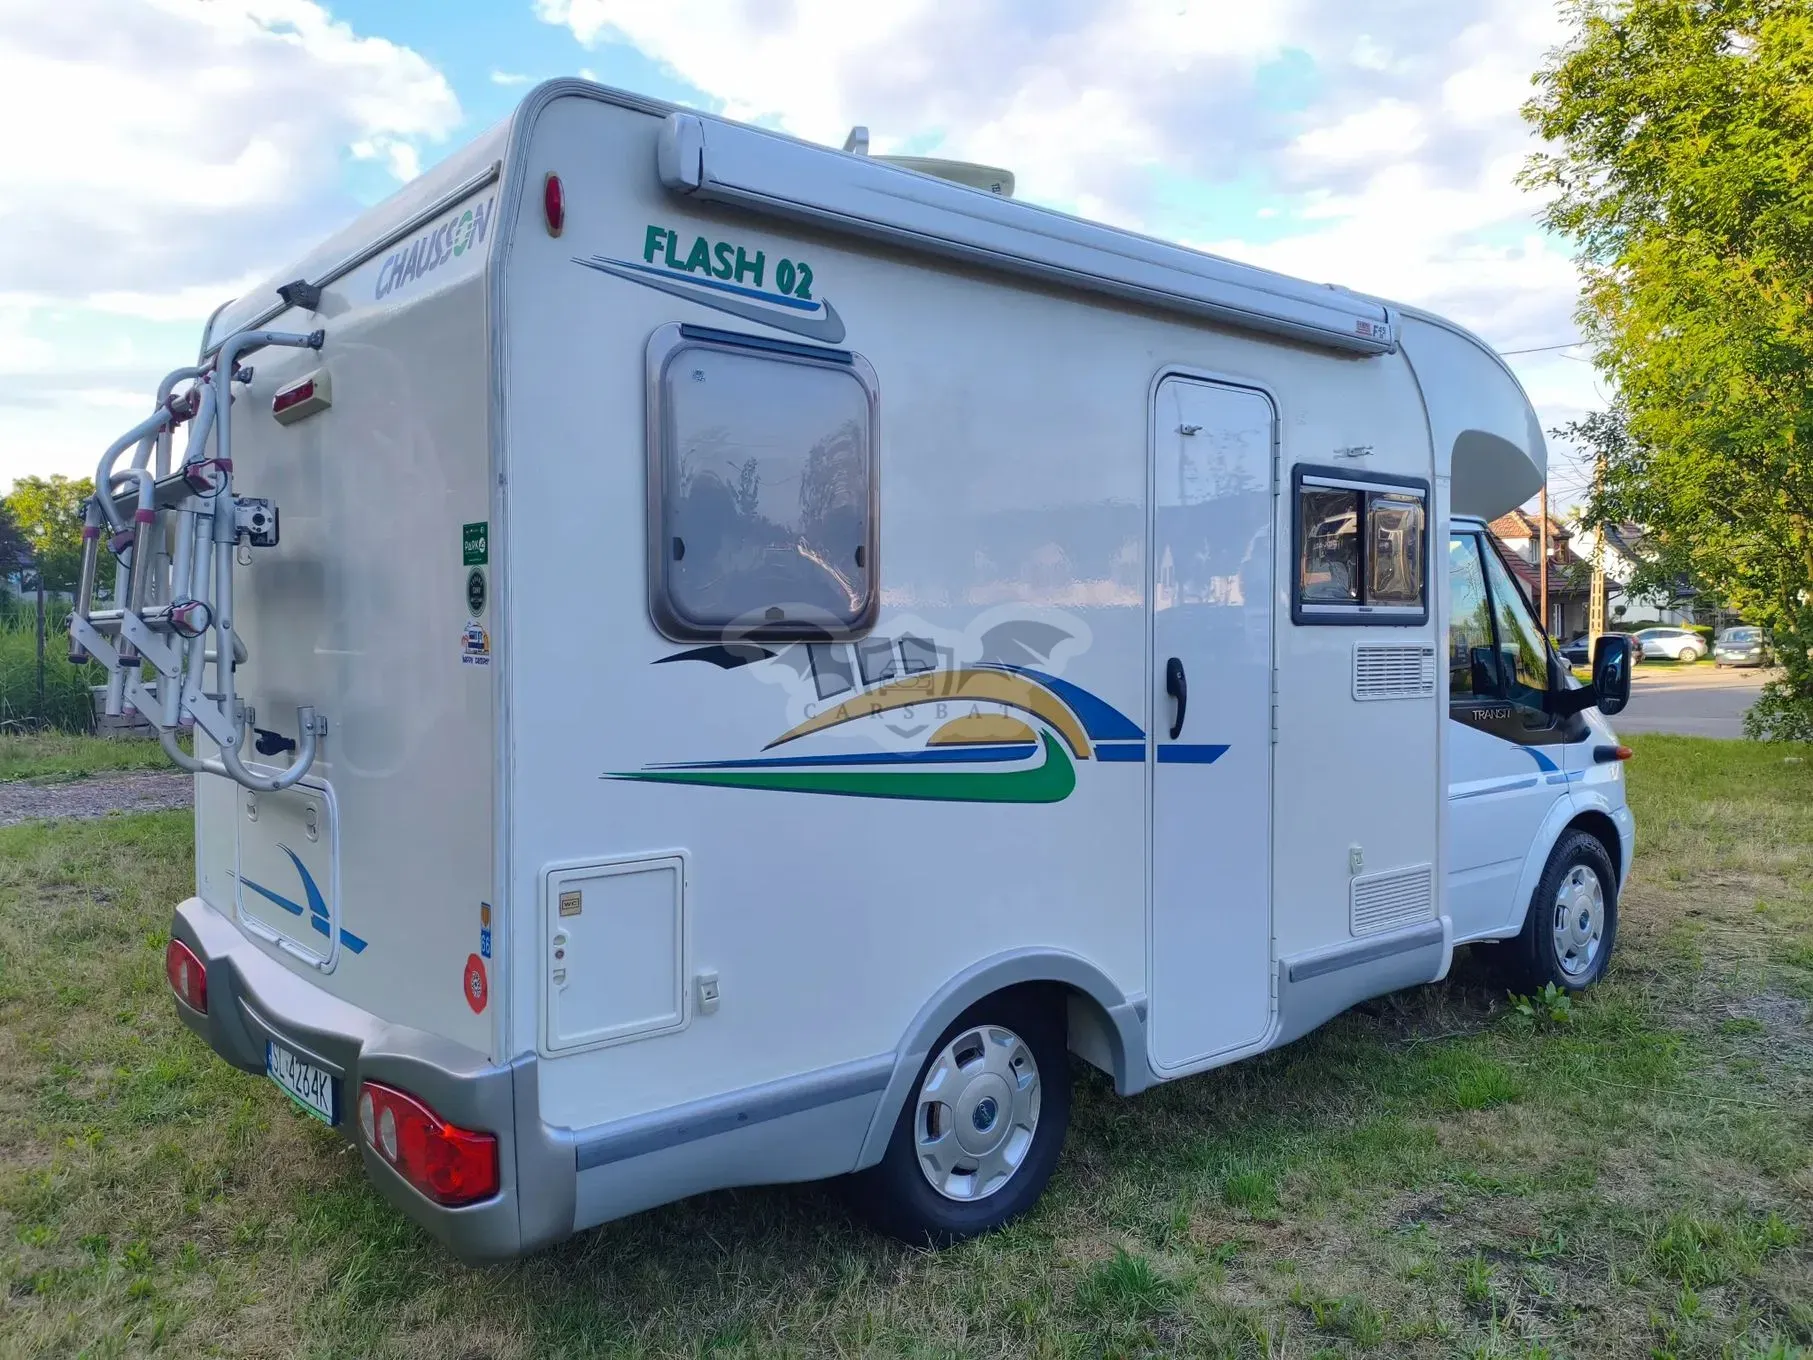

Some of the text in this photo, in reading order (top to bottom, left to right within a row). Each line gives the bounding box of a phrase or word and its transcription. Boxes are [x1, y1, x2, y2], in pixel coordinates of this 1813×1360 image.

[375, 196, 494, 300] CHAUSSON
[643, 224, 813, 300] FLASH 02
[1472, 708, 1511, 720] TRANSIT
[273, 1043, 329, 1112] SL 4264K
